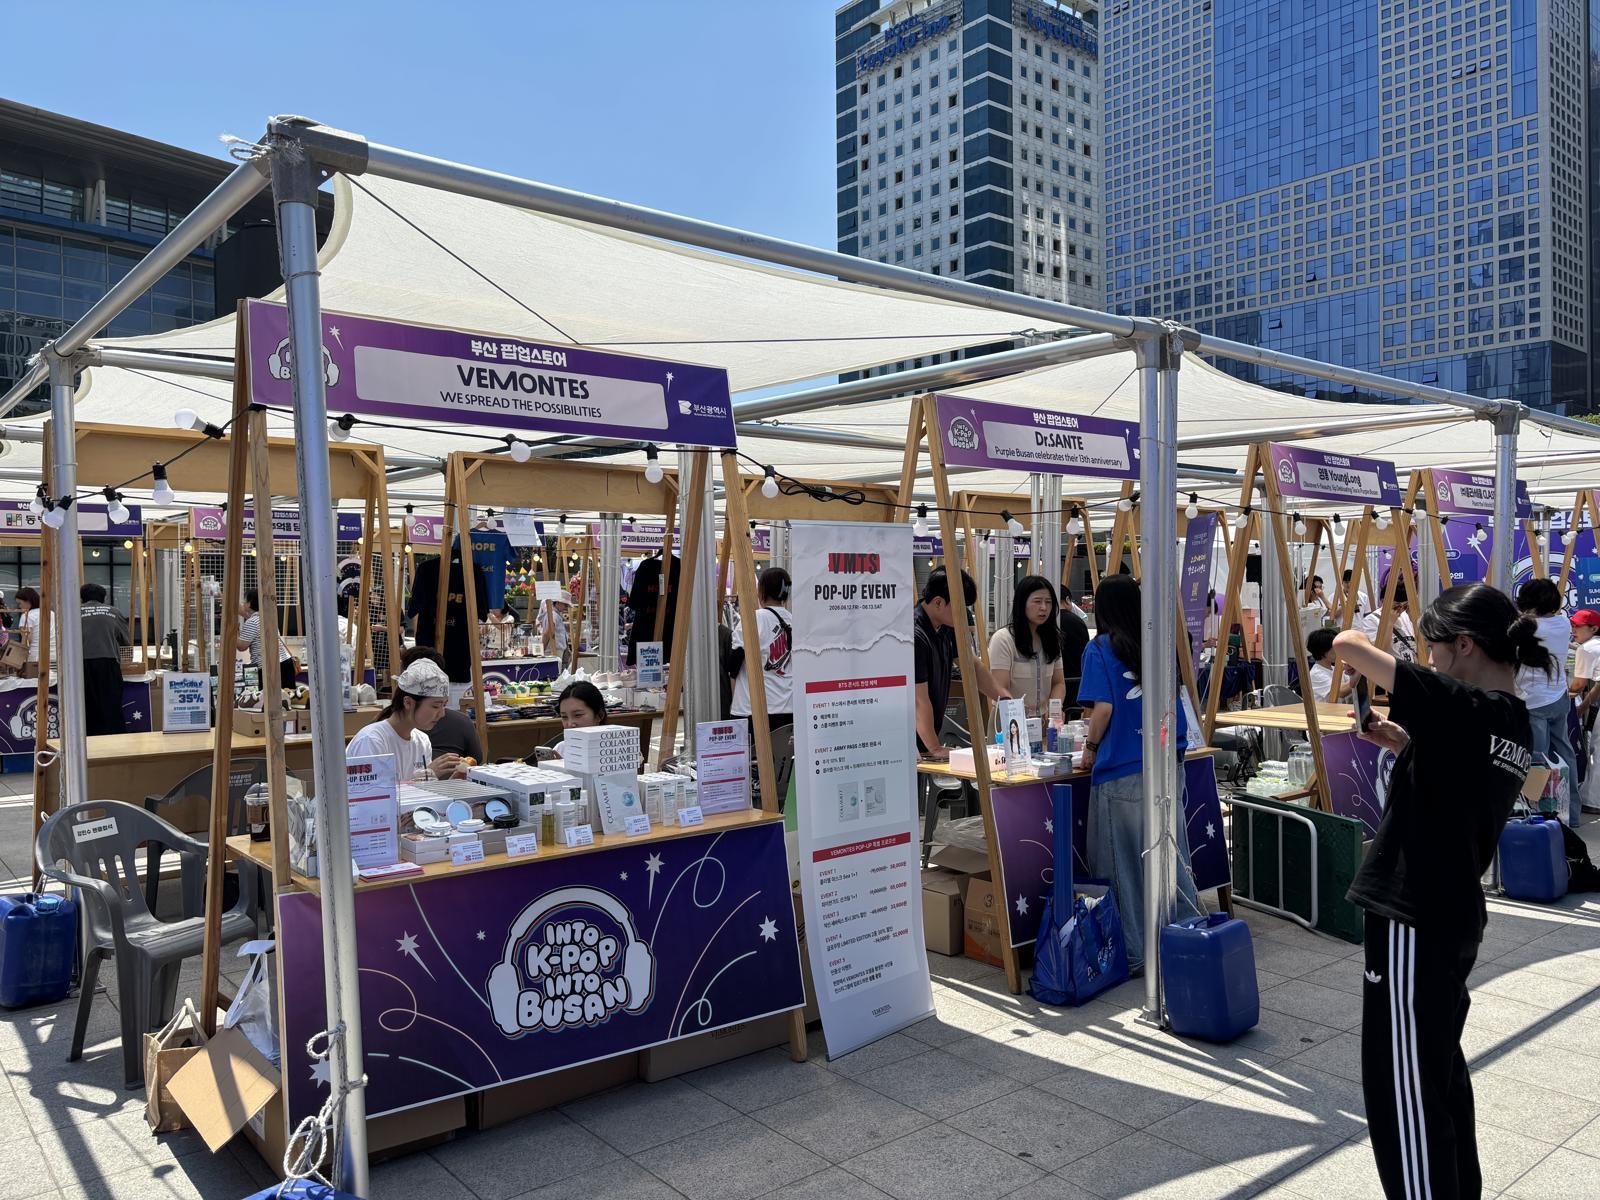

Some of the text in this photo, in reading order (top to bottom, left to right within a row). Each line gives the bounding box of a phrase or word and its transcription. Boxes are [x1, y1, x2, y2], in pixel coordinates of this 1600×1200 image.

[471, 340, 567, 367] 부산 팝업스토어
[457, 365, 590, 400] VEMONTES
[440, 391, 602, 418] WE SPREAD THE POSSIBILITIES
[693, 404, 727, 415] 부산광역시
[1033, 412, 1079, 428] 부산 팝업스토어
[1034, 431, 1084, 450] Dr.SANTE
[995, 446, 1122, 468] Purple Busan celebrates their 13th anniversary
[1329, 470, 1362, 487] YoungLong
[832, 553, 878, 574] VMTS
[814, 584, 897, 600] POP-UP EVENT
[178, 694, 204, 703] 35%
[600, 729, 639, 740] COLLAMELT
[600, 738, 639, 748] COLLAMELT
[600, 746, 639, 757] COLLAMELT
[600, 754, 639, 765] COLLAMELT
[600, 762, 639, 773] COLLAMELT
[359, 774, 378, 782] EVENT
[545, 920, 600, 946] INTO
[526, 936, 618, 978] K-POP
[544, 972, 601, 997] INTO
[516, 976, 629, 1028] BUSAN
